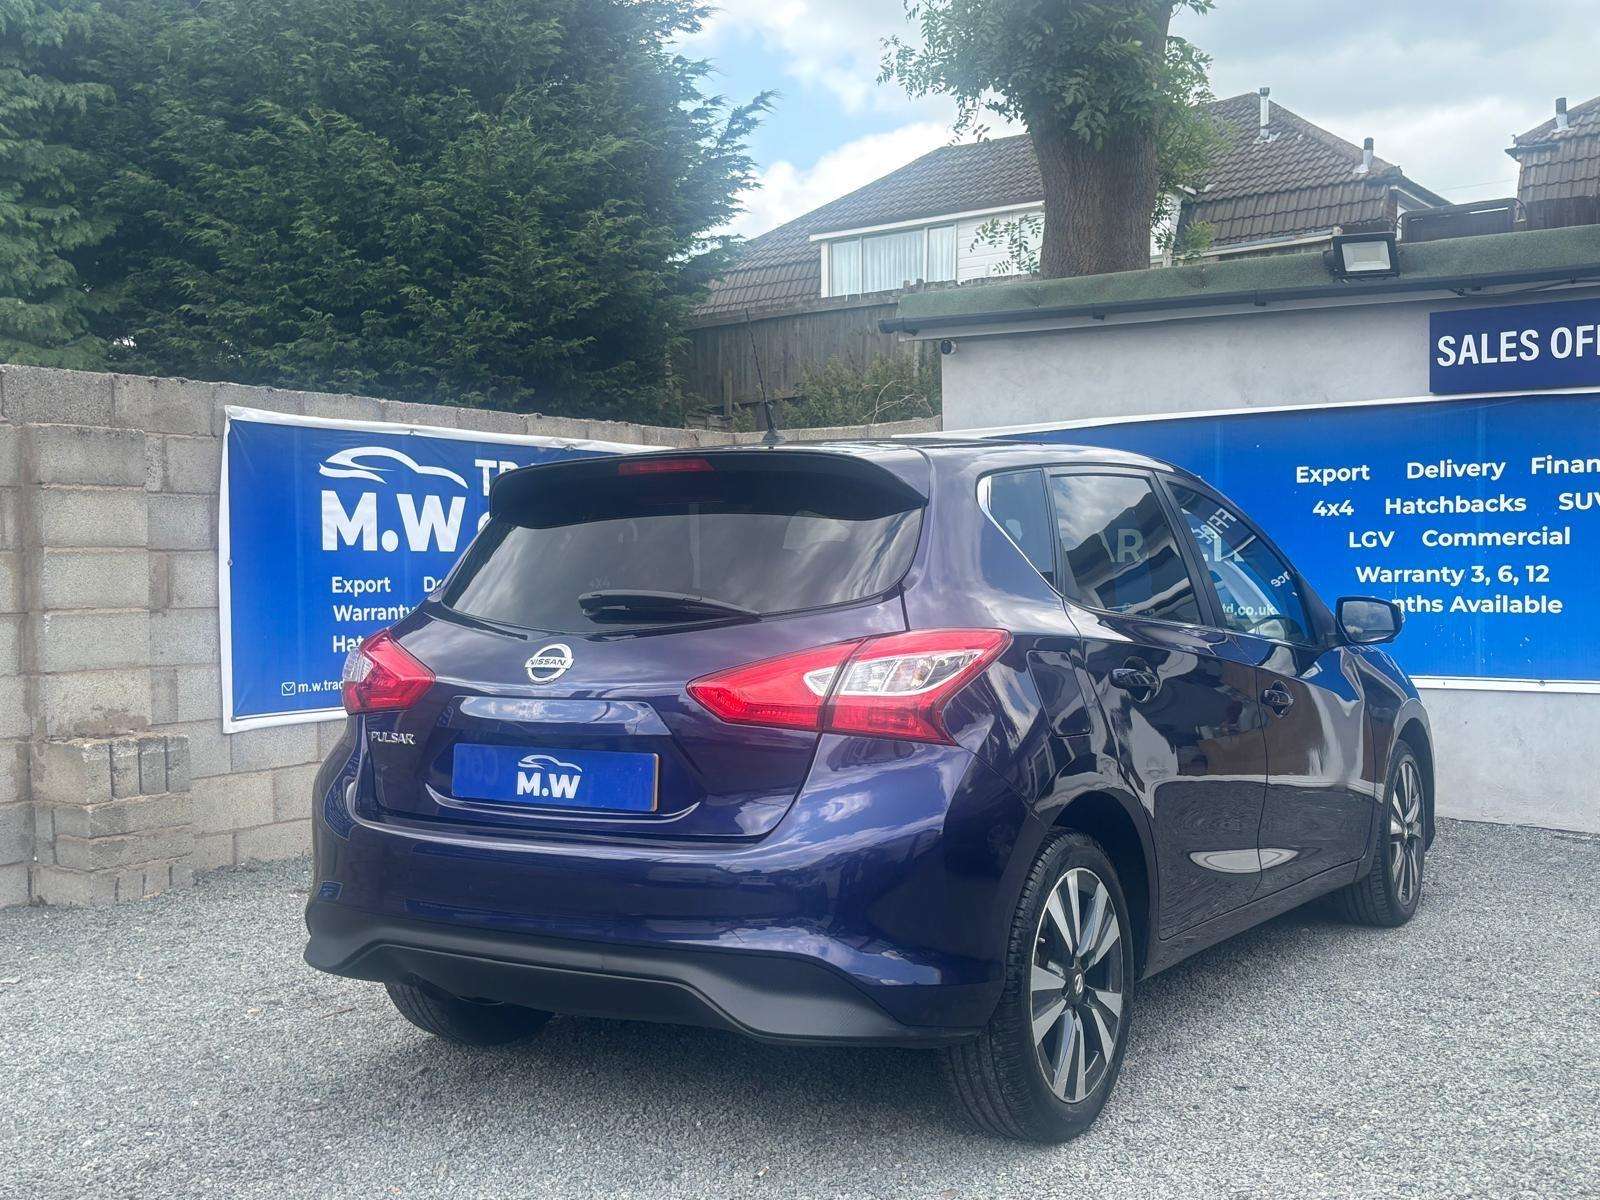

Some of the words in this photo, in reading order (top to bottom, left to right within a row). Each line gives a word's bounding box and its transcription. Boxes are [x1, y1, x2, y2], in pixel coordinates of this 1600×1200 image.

[1436, 329, 1540, 367] SALES
[1550, 324, 1600, 359] OF
[1296, 464, 1370, 487] Export
[1407, 459, 1506, 480] Delivery
[1531, 454, 1600, 475] Finan
[1312, 499, 1355, 517] 4x4
[1385, 493, 1527, 515] Hatchbacks
[321, 490, 467, 553] M.W
[1349, 531, 1396, 548] LGV
[1421, 526, 1571, 547] Commercial
[331, 576, 392, 597] Export
[1355, 566, 1465, 587] Warranty
[1470, 566, 1491, 585] 3,
[1497, 565, 1519, 585] 6,
[1525, 564, 1550, 583] 12
[1449, 594, 1563, 614] Available
[529, 658, 567, 667] NISSAN
[370, 731, 415, 745] PULSAR
[516, 771, 582, 799] M.W
